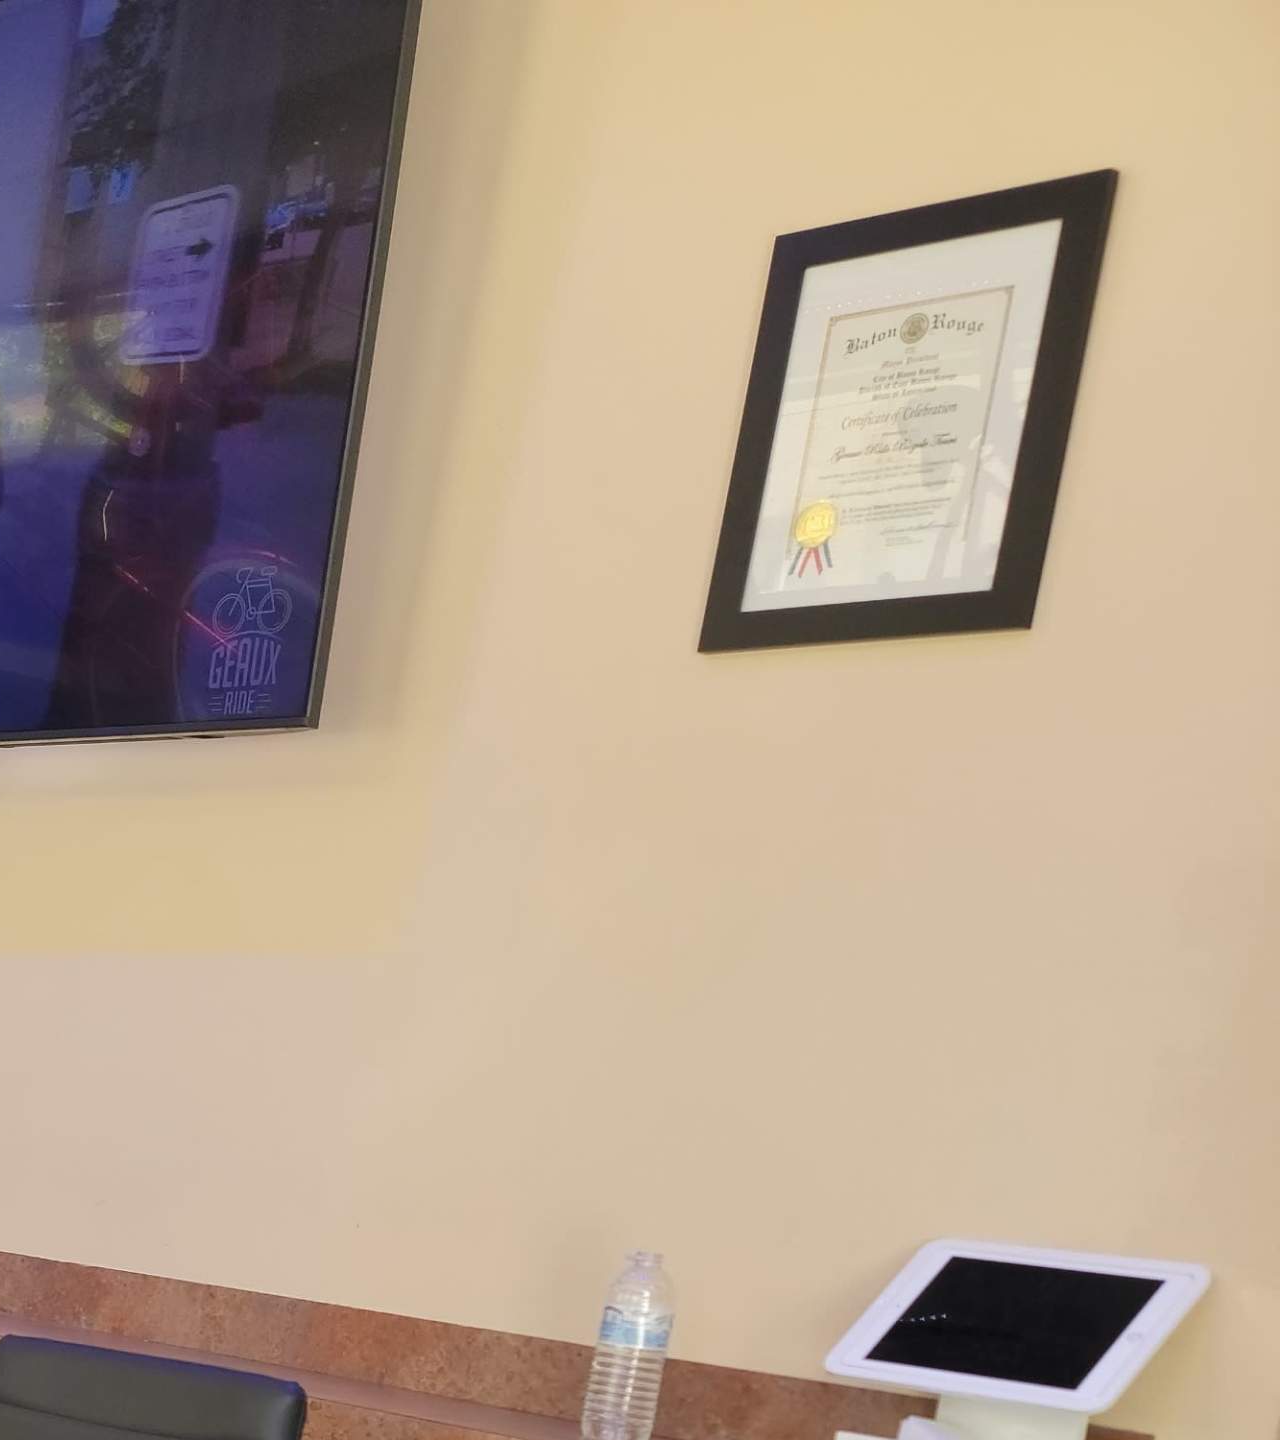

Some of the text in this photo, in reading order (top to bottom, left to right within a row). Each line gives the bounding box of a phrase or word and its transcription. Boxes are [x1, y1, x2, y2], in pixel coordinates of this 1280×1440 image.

[844, 313, 984, 357] Baton Rouge
[208, 637, 282, 689] GEAUX
[223, 690, 255, 715] RIDE
